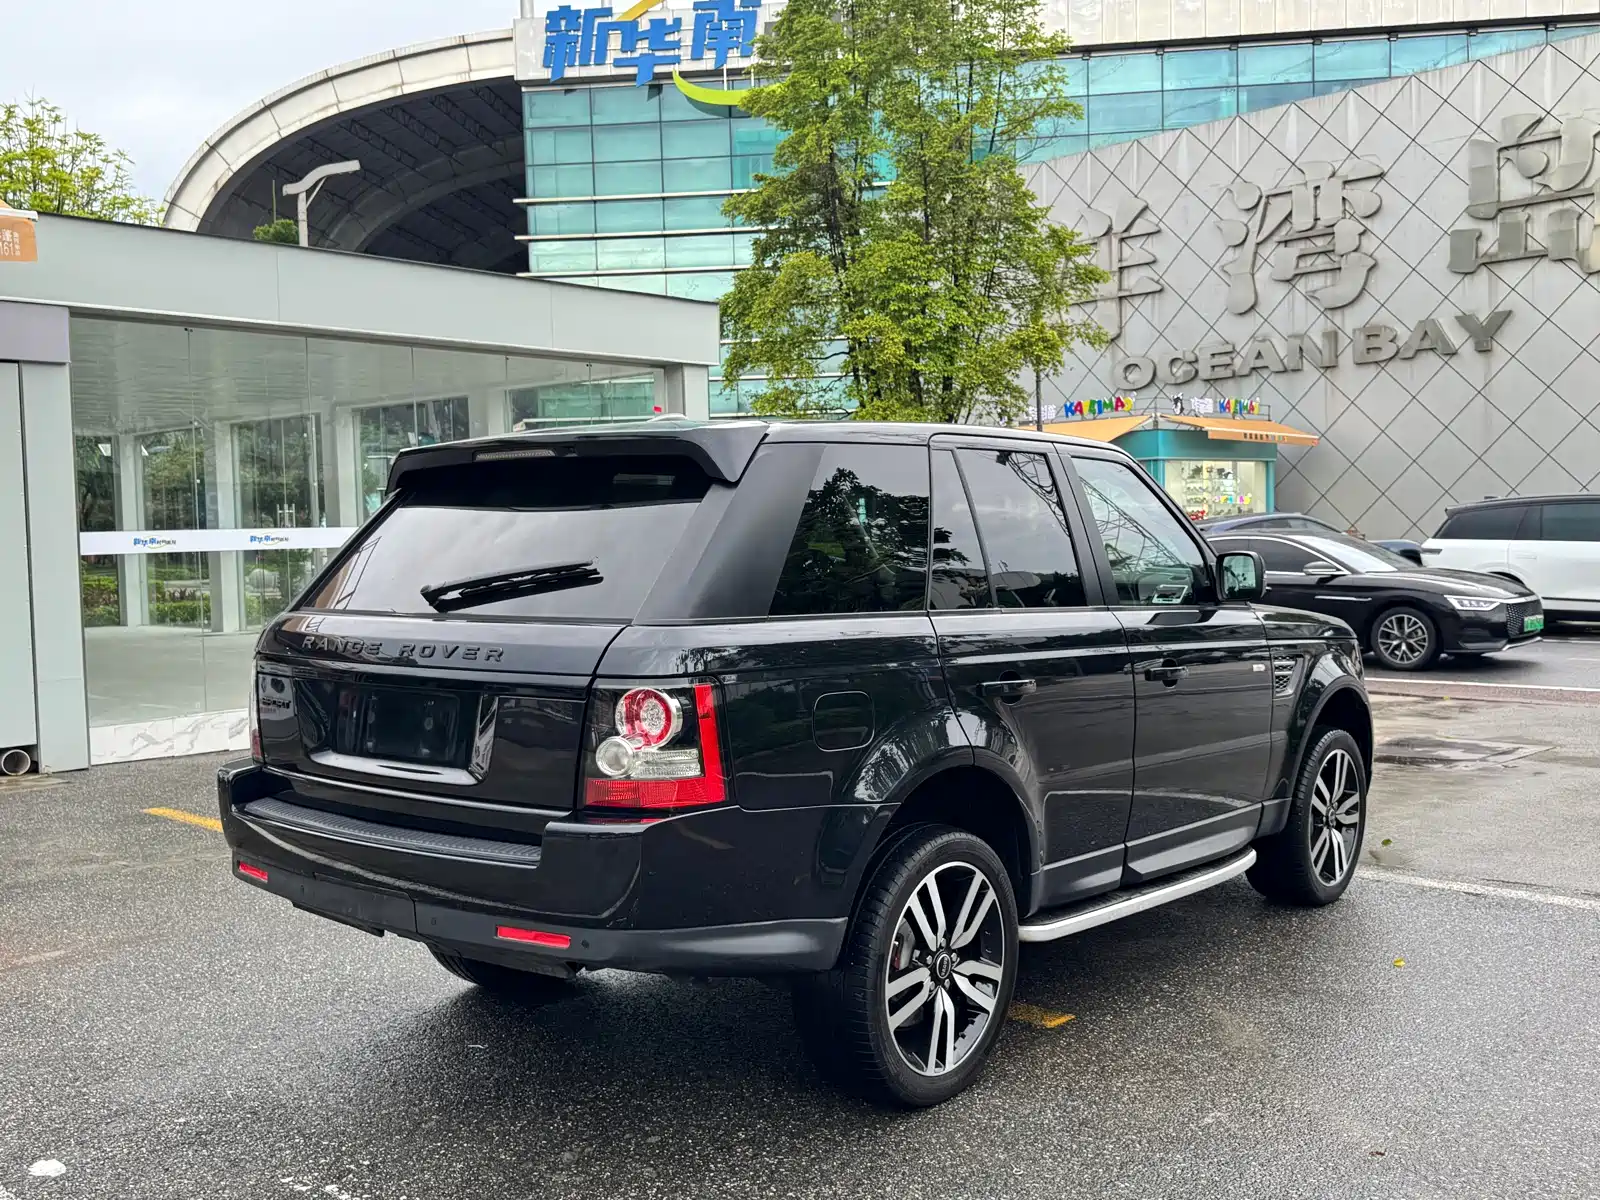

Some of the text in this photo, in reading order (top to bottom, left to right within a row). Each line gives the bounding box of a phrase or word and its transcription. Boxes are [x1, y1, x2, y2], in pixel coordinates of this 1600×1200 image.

[543, 0, 761, 87] 新华南
[1112, 309, 1513, 390] OCEAN BAY
[301, 636, 504, 662] RANGE ROVER
